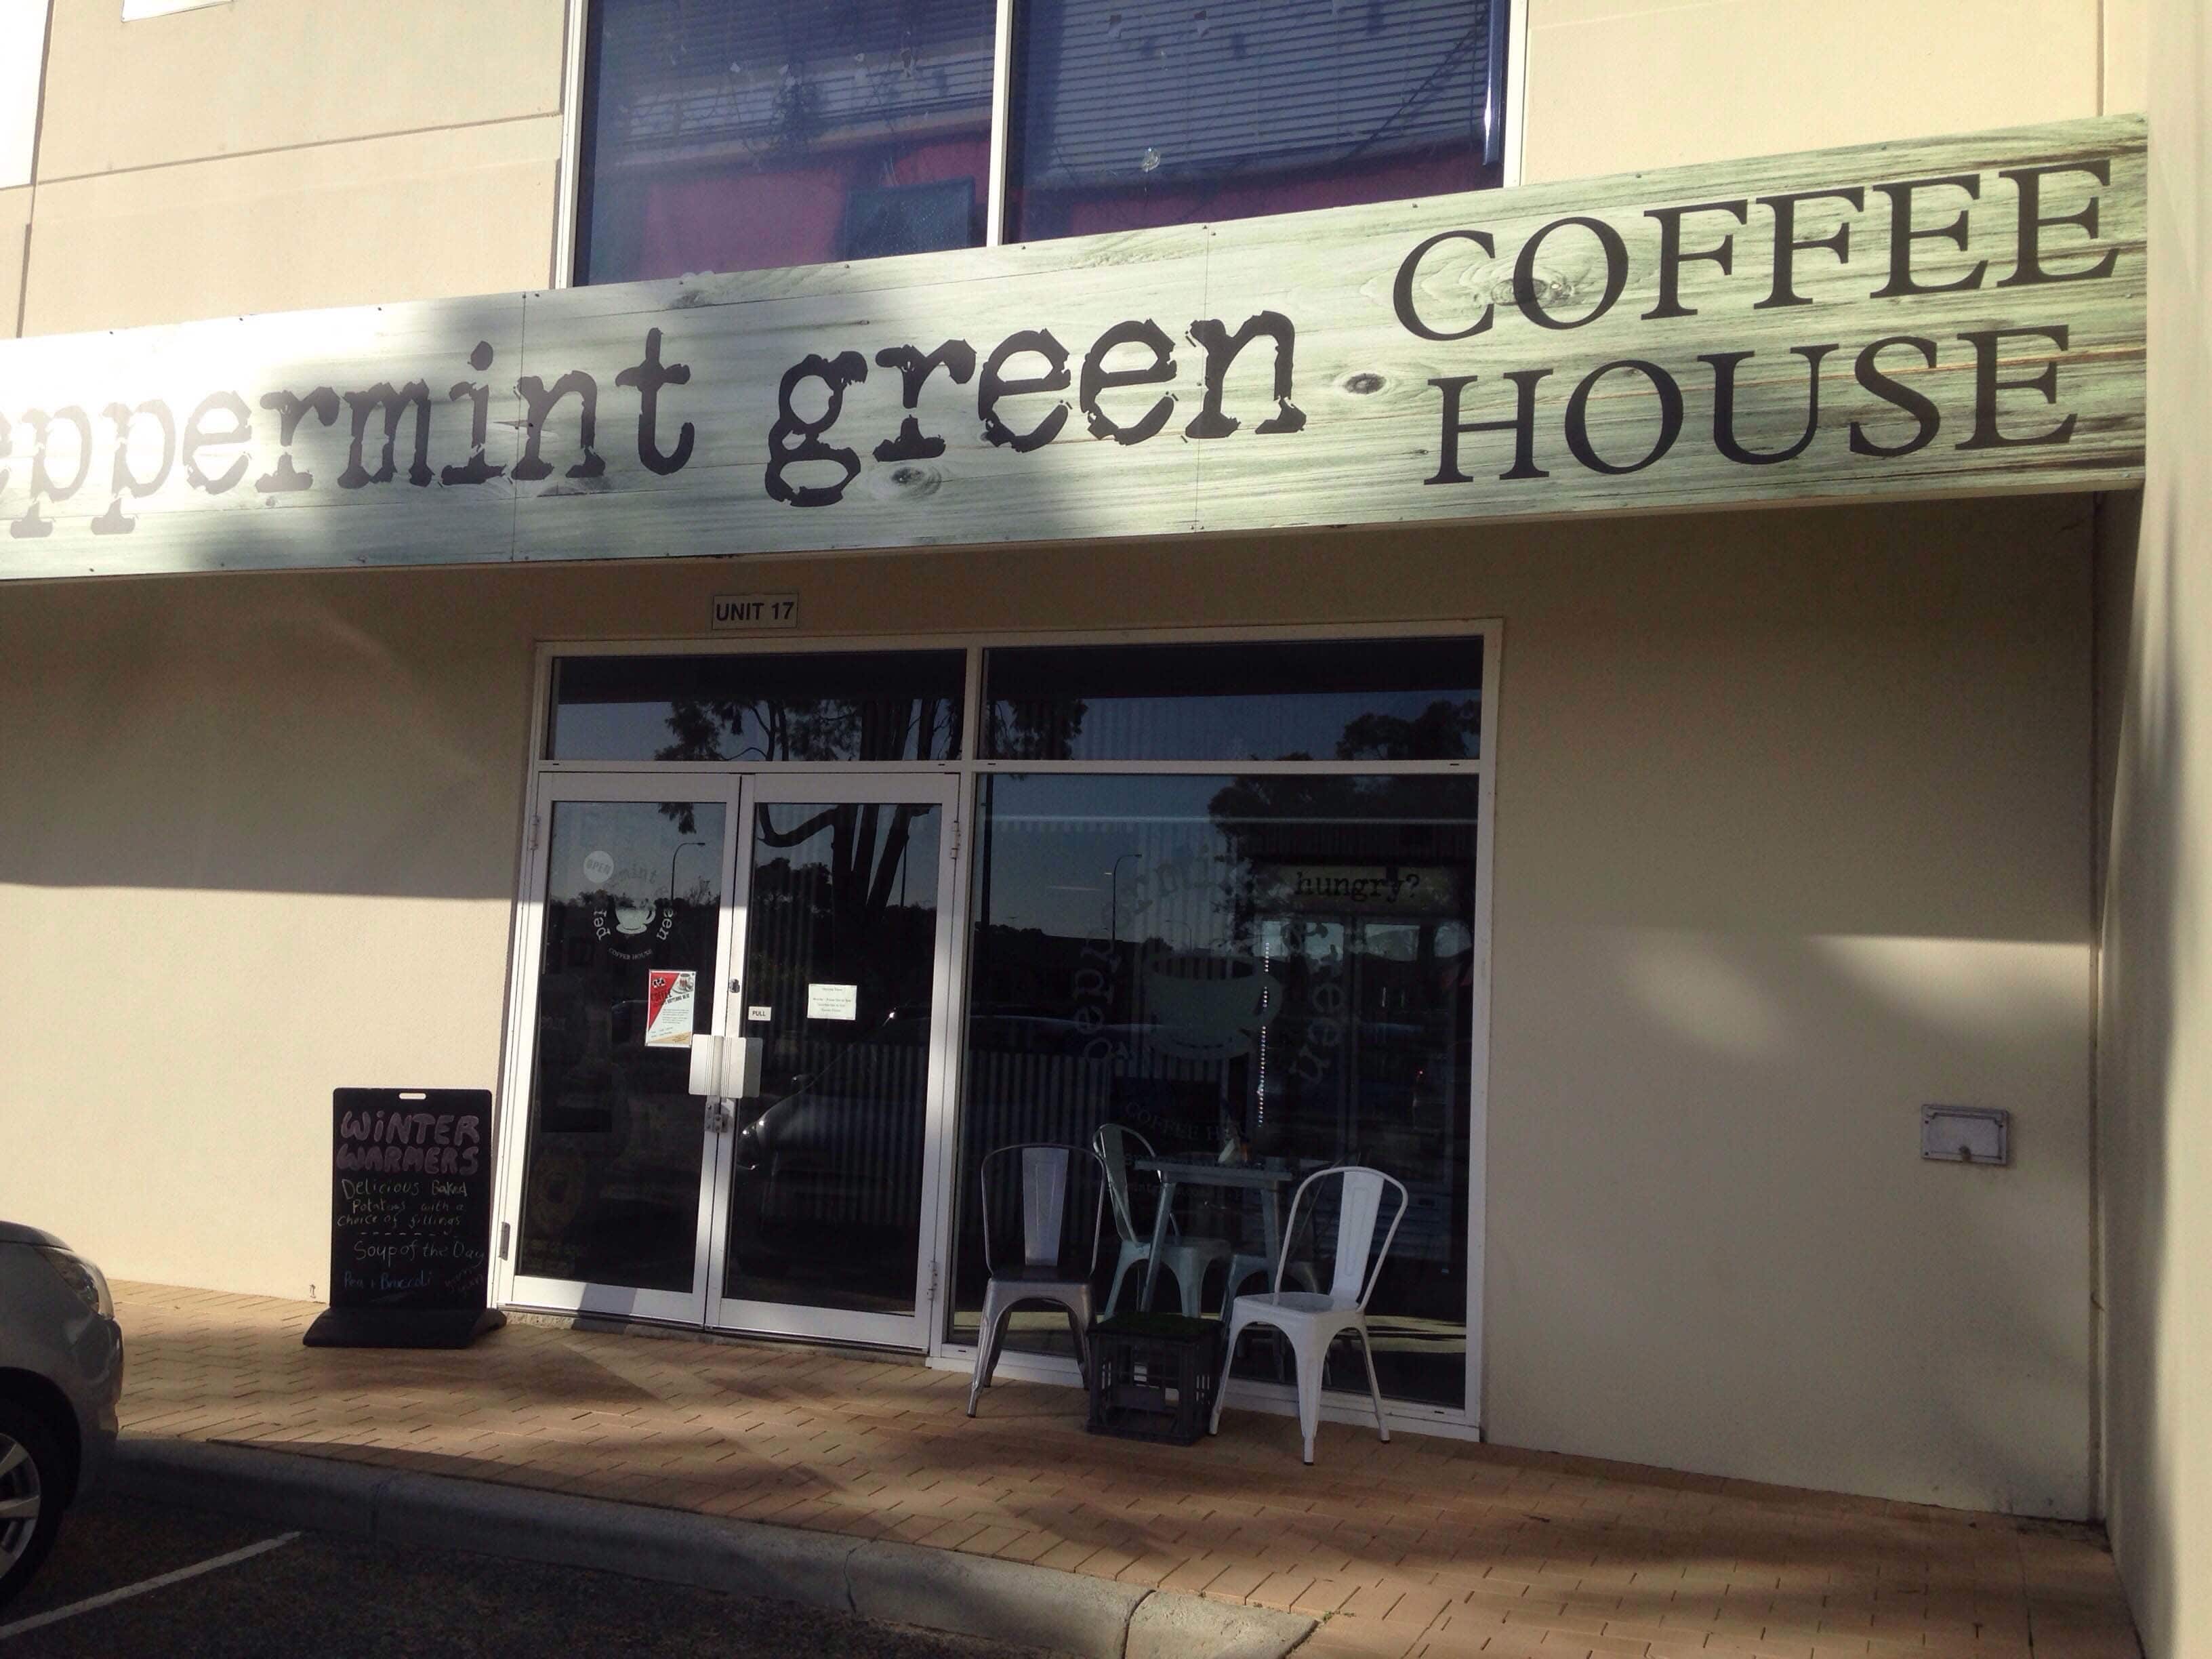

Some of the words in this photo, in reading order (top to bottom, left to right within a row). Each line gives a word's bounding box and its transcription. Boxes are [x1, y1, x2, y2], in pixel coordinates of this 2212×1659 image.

[1391, 158, 2121, 342] COFFEE
[1423, 324, 2079, 486] HOUSE
[0, 327, 695, 539] ppermint
[764, 309, 1307, 507] green
[716, 602, 765, 621] UNIT
[771, 601, 794, 620] 17
[586, 858, 611, 876] OPEN
[1294, 872, 1421, 903] hungry?
[336, 1143, 480, 1176] WARMERS
[342, 1178, 419, 1200] Delicious
[354, 1240, 396, 1267] Soup
[400, 1239, 417, 1261] of
[423, 1242, 449, 1258] the
[453, 1242, 485, 1269] Day
